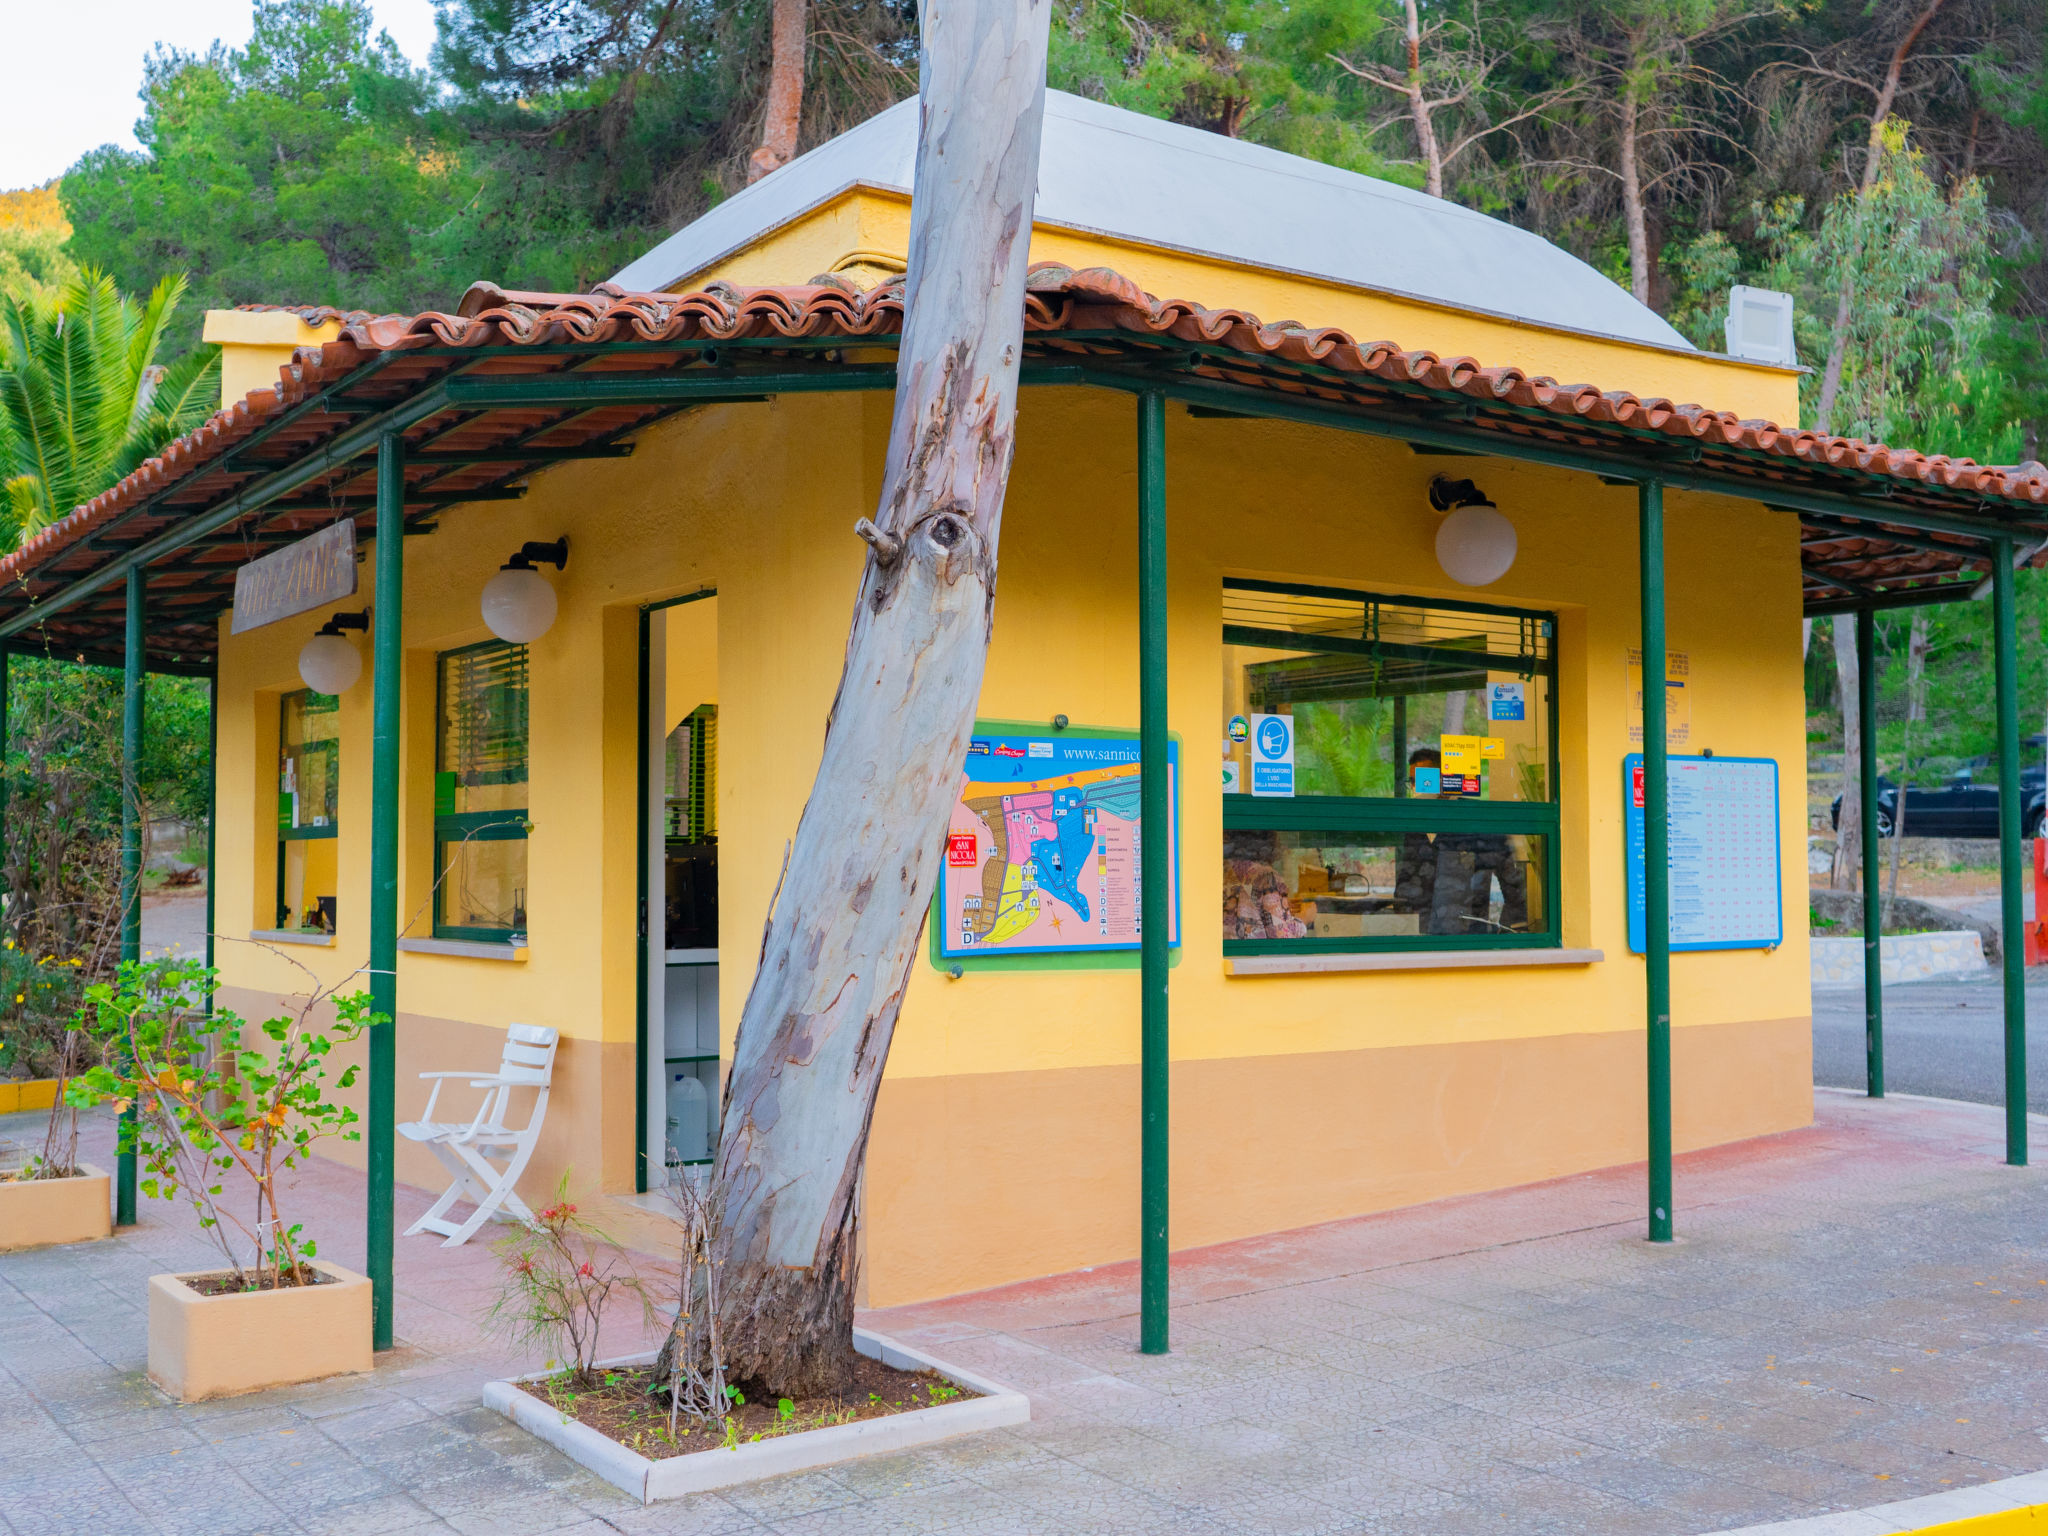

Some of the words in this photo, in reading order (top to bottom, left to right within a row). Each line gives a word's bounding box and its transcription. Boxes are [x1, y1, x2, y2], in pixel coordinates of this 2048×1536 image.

[956, 840, 969, 850] SAN
[951, 850, 975, 860] NICOLA
[963, 933, 972, 944] D
